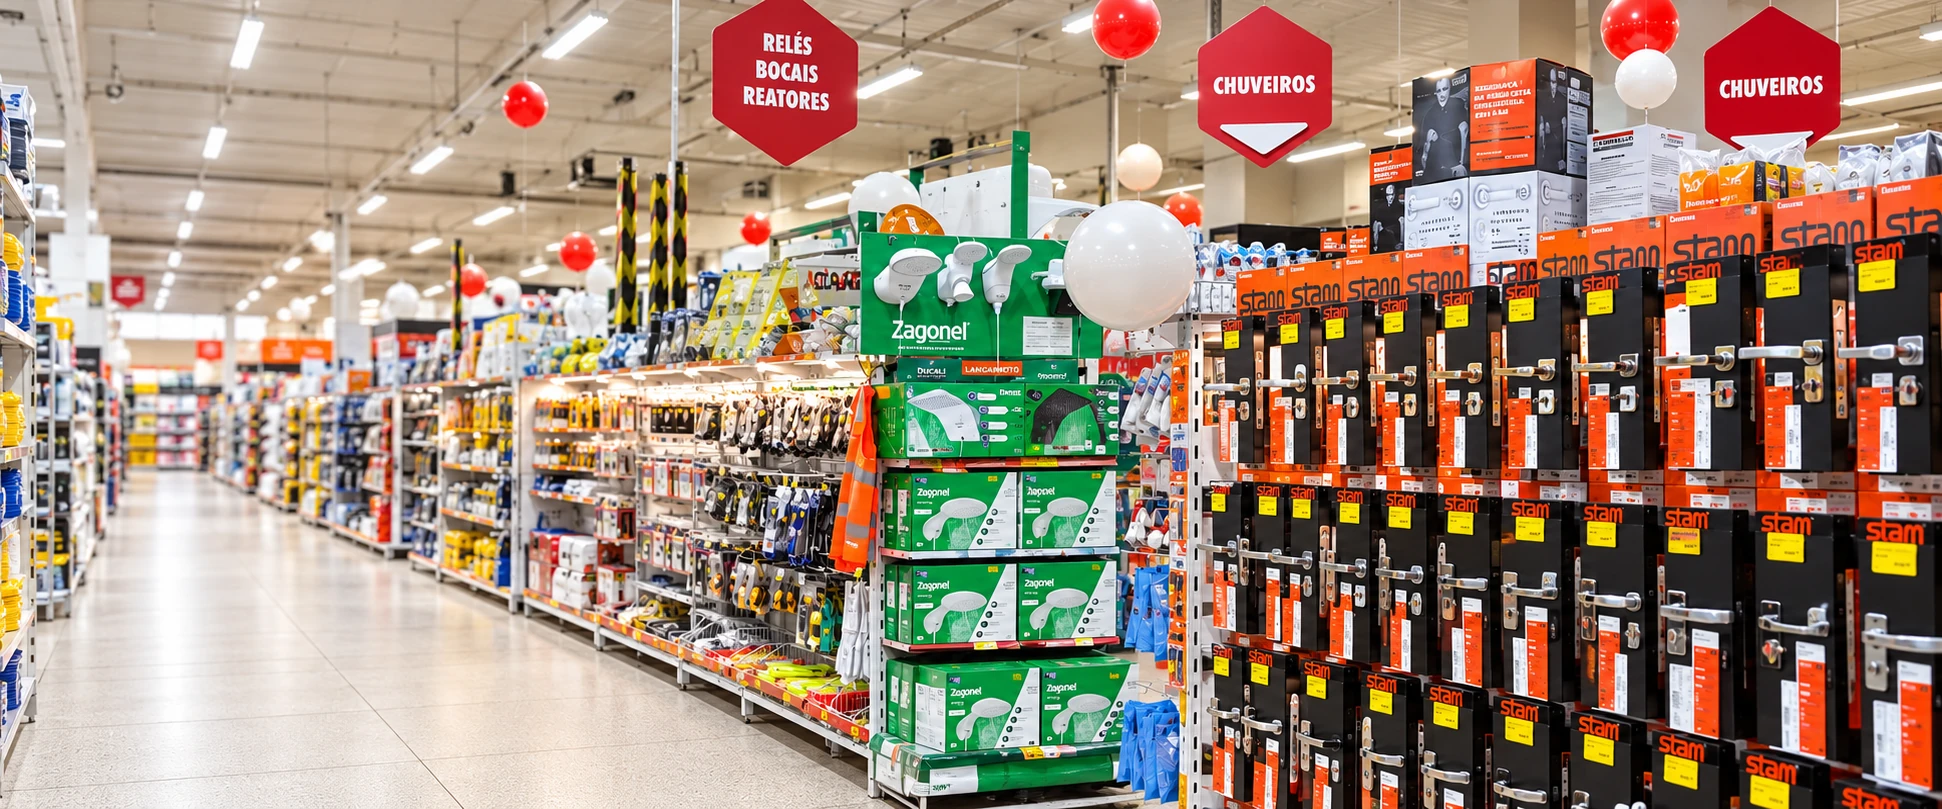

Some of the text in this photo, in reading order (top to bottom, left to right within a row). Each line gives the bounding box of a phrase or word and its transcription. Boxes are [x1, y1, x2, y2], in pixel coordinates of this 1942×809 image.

[763, 31, 813, 55] RELÉS
[755, 59, 819, 84] BOCAIS
[1213, 74, 1316, 95] CHUVEIROS
[1719, 75, 1824, 99] CHUVEIROS
[743, 85, 830, 112] REATORES
[1853, 241, 1904, 264] stam
[1675, 261, 1722, 282] stam
[1505, 282, 1540, 300] stam
[1581, 274, 1619, 293] stam
[1380, 298, 1408, 315] stam
[1442, 291, 1473, 307] stam
[1278, 311, 1302, 326] stam
[1323, 306, 1349, 320] stam
[891, 319, 967, 344] Zagonel
[1222, 317, 1243, 332] stam
[1256, 483, 1280, 497] stam
[1290, 486, 1316, 500] stam
[1336, 488, 1364, 504] stam
[1386, 491, 1416, 509] stam
[1444, 495, 1479, 513] stam
[1511, 499, 1549, 519] stam
[1583, 503, 1623, 524] stam
[1664, 508, 1709, 530] stam
[1761, 512, 1812, 536] stam
[1865, 519, 1925, 546] stam
[1248, 649, 1273, 668] stam
[1304, 661, 1331, 680] stam
[1366, 673, 1397, 694] stam
[1429, 685, 1463, 708] stam
[1500, 698, 1539, 723] stam
[1578, 715, 1619, 741] stam
[1658, 734, 1704, 763] stam
[1745, 754, 1797, 785] stam
[1841, 787, 1900, 809] stam
